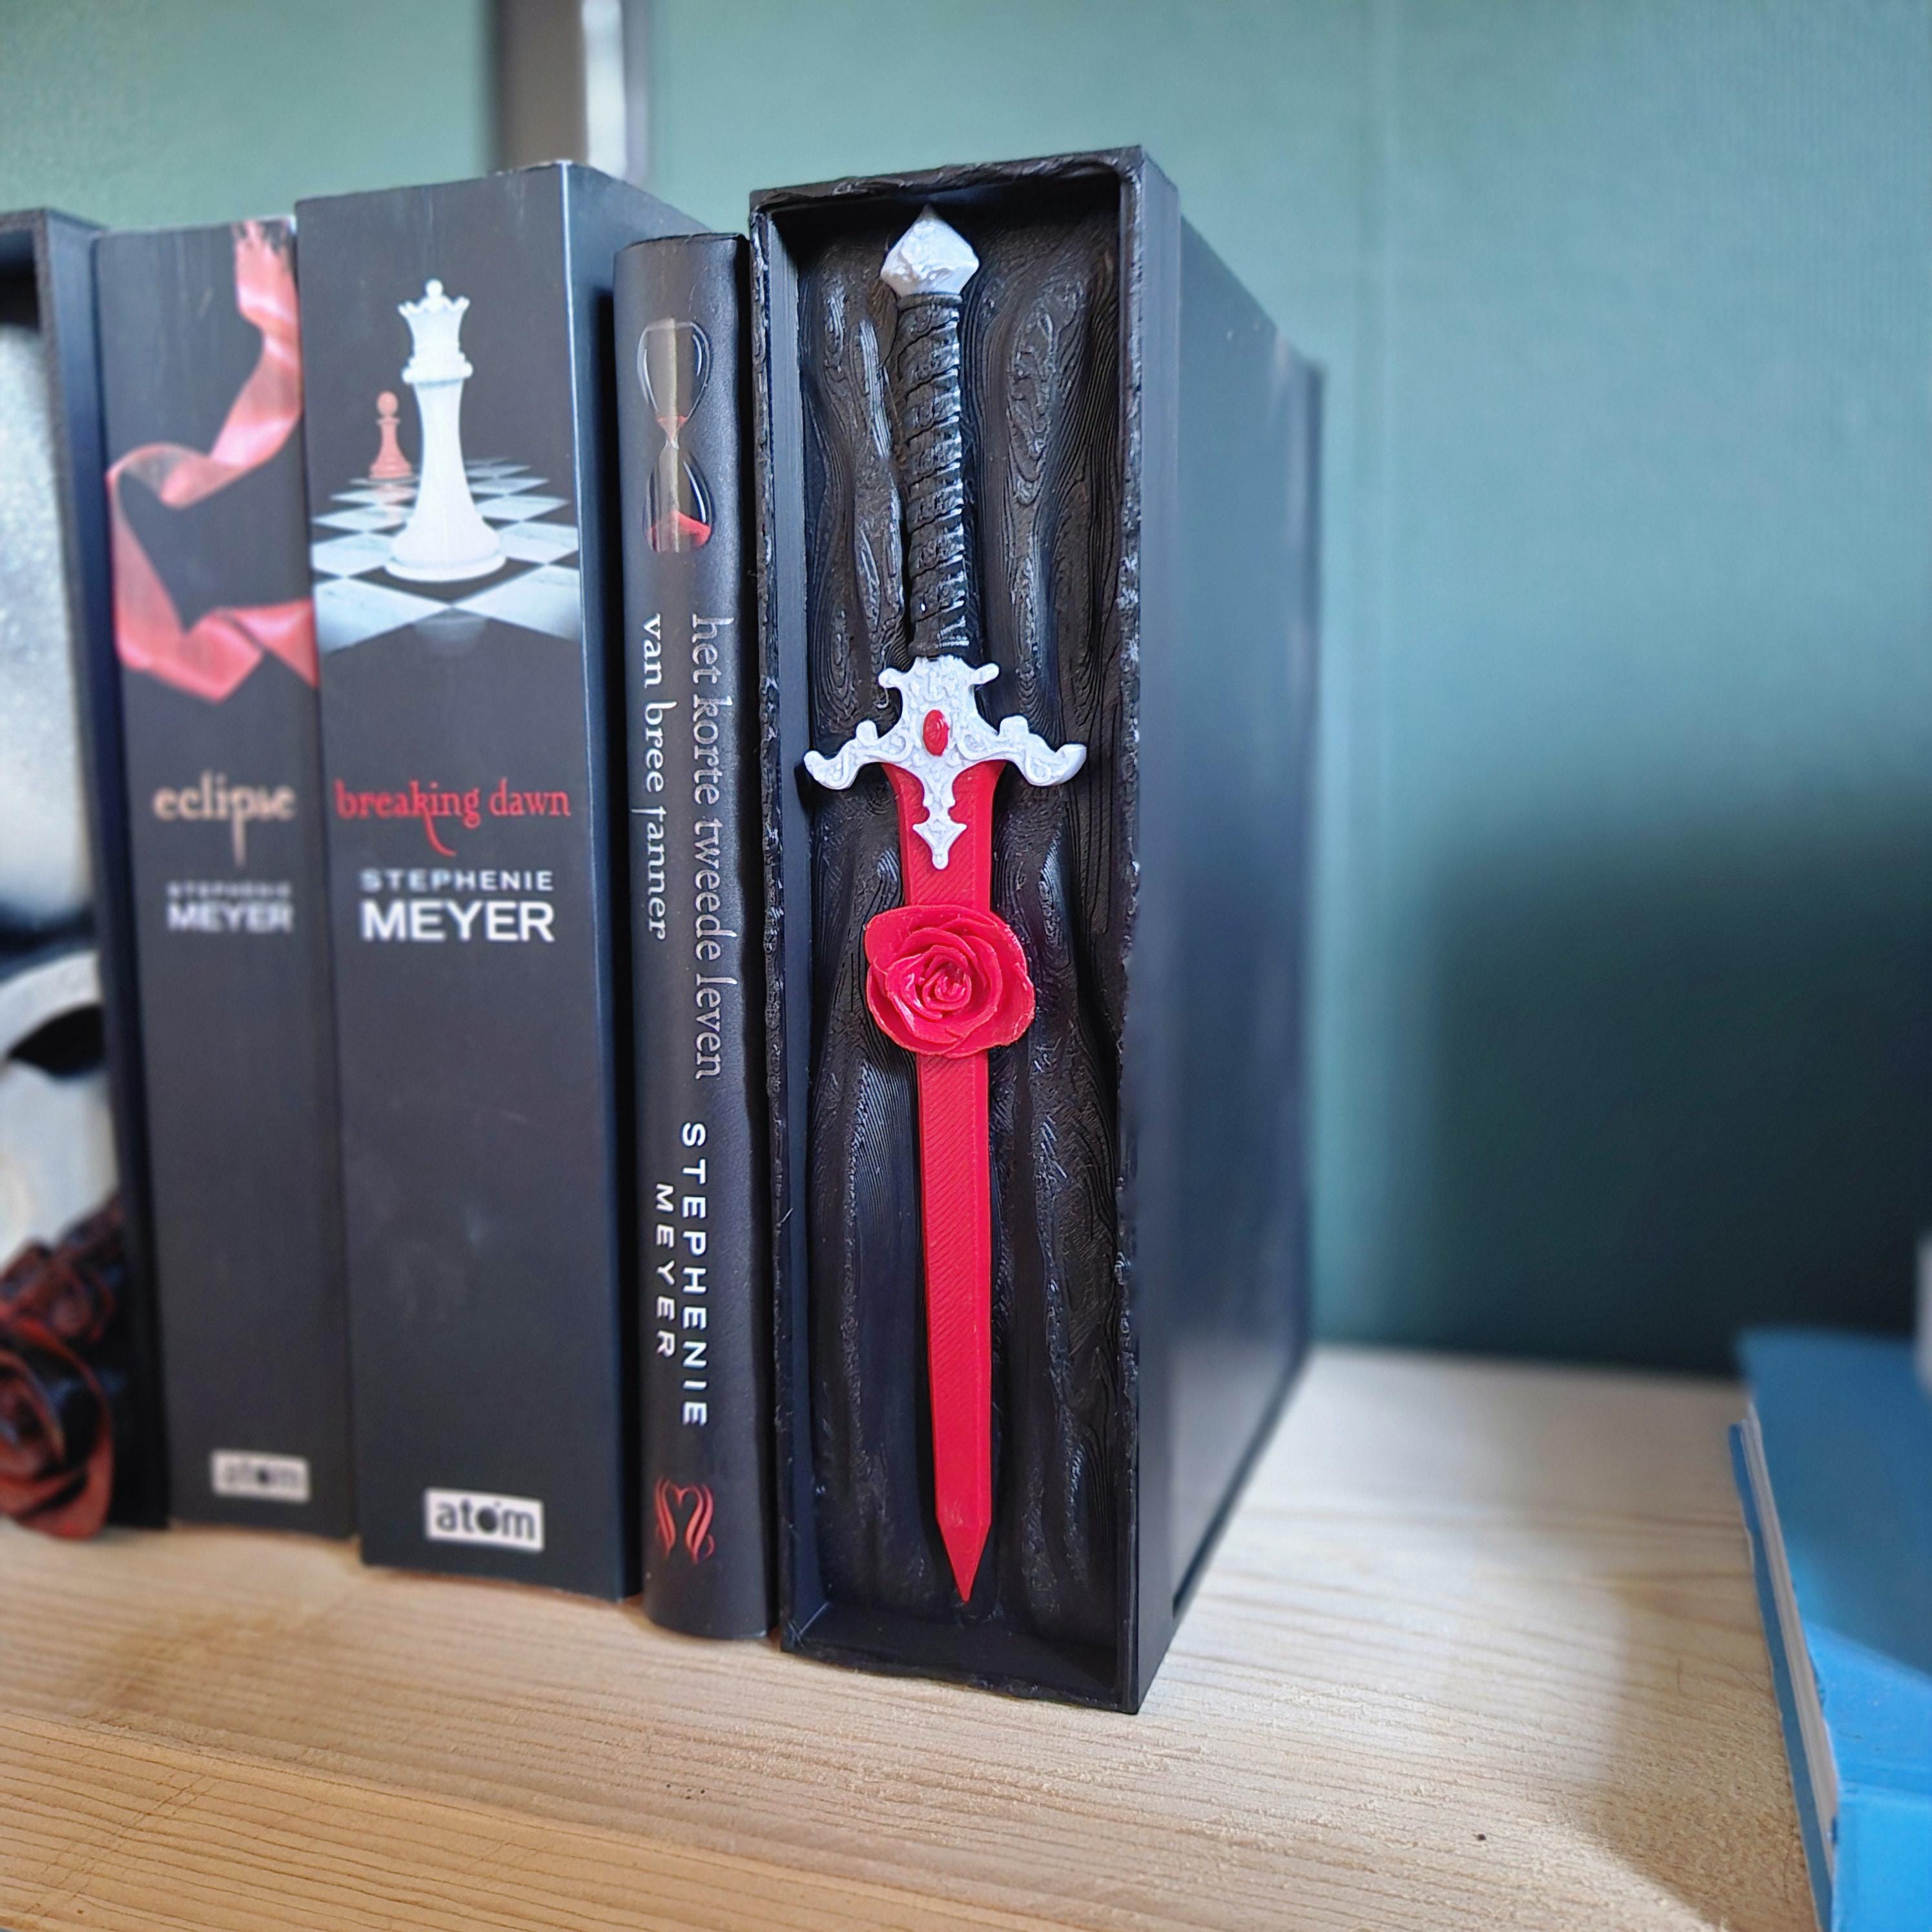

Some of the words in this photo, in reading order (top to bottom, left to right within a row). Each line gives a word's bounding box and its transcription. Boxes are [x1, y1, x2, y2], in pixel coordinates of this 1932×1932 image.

[642, 613, 663, 689] van
[691, 612, 735, 684] het
[644, 701, 677, 794] bree
[692, 694, 733, 806] korte
[334, 779, 480, 857] breaking
[489, 777, 571, 817] dawn
[360, 869, 554, 892] STEPHENIE
[631, 806, 668, 940] tanner
[694, 818, 737, 961] tweede
[167, 901, 294, 932] MEYER
[360, 900, 555, 942] MEYER
[695, 973, 737, 1080] leven
[655, 1184, 674, 1357] MEYER
[681, 1122, 708, 1426] STEPHENIE
[435, 1498, 535, 1541] atom
